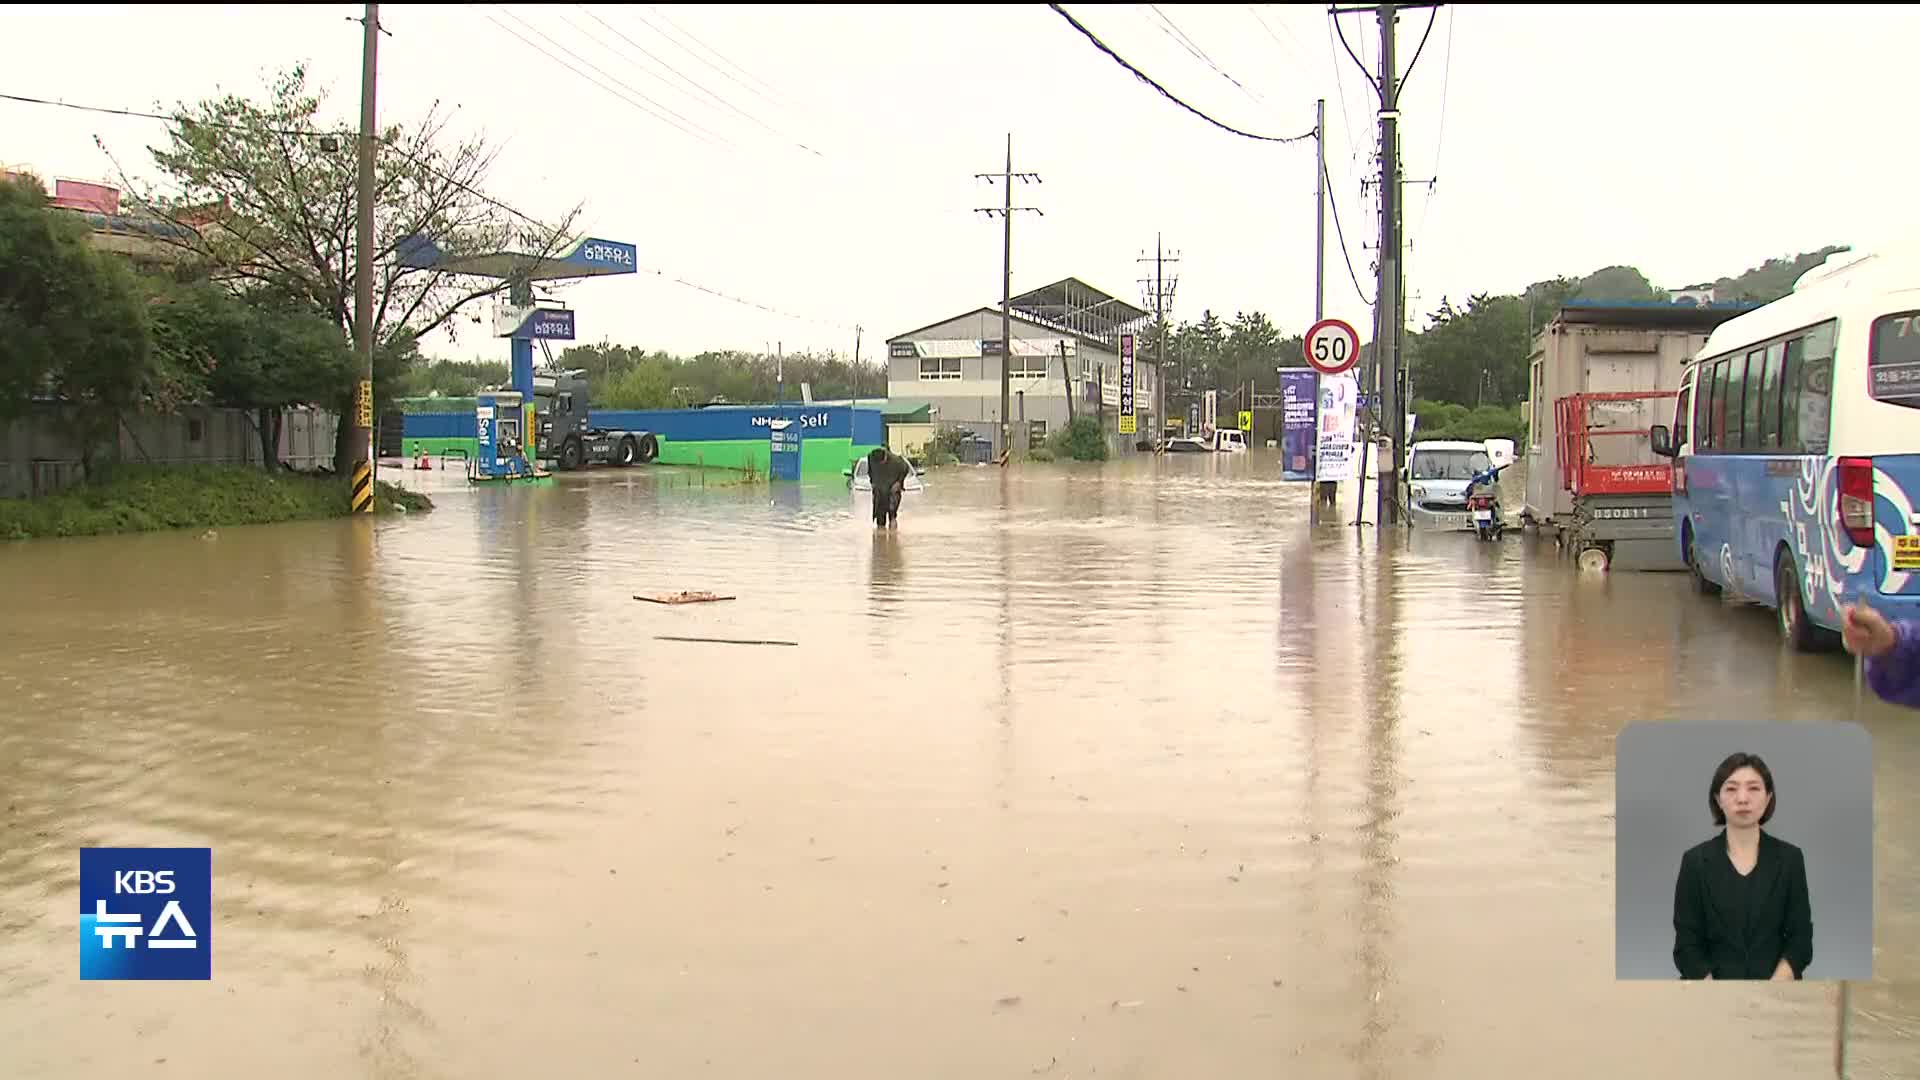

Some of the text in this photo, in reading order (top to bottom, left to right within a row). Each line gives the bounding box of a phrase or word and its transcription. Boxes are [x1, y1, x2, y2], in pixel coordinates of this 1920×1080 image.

[584, 244, 633, 266] 농협주유소
[534, 322, 571, 336] 농협주유소
[1315, 337, 1346, 361] 50
[799, 412, 828, 428] Self
[479, 418, 490, 447] Self
